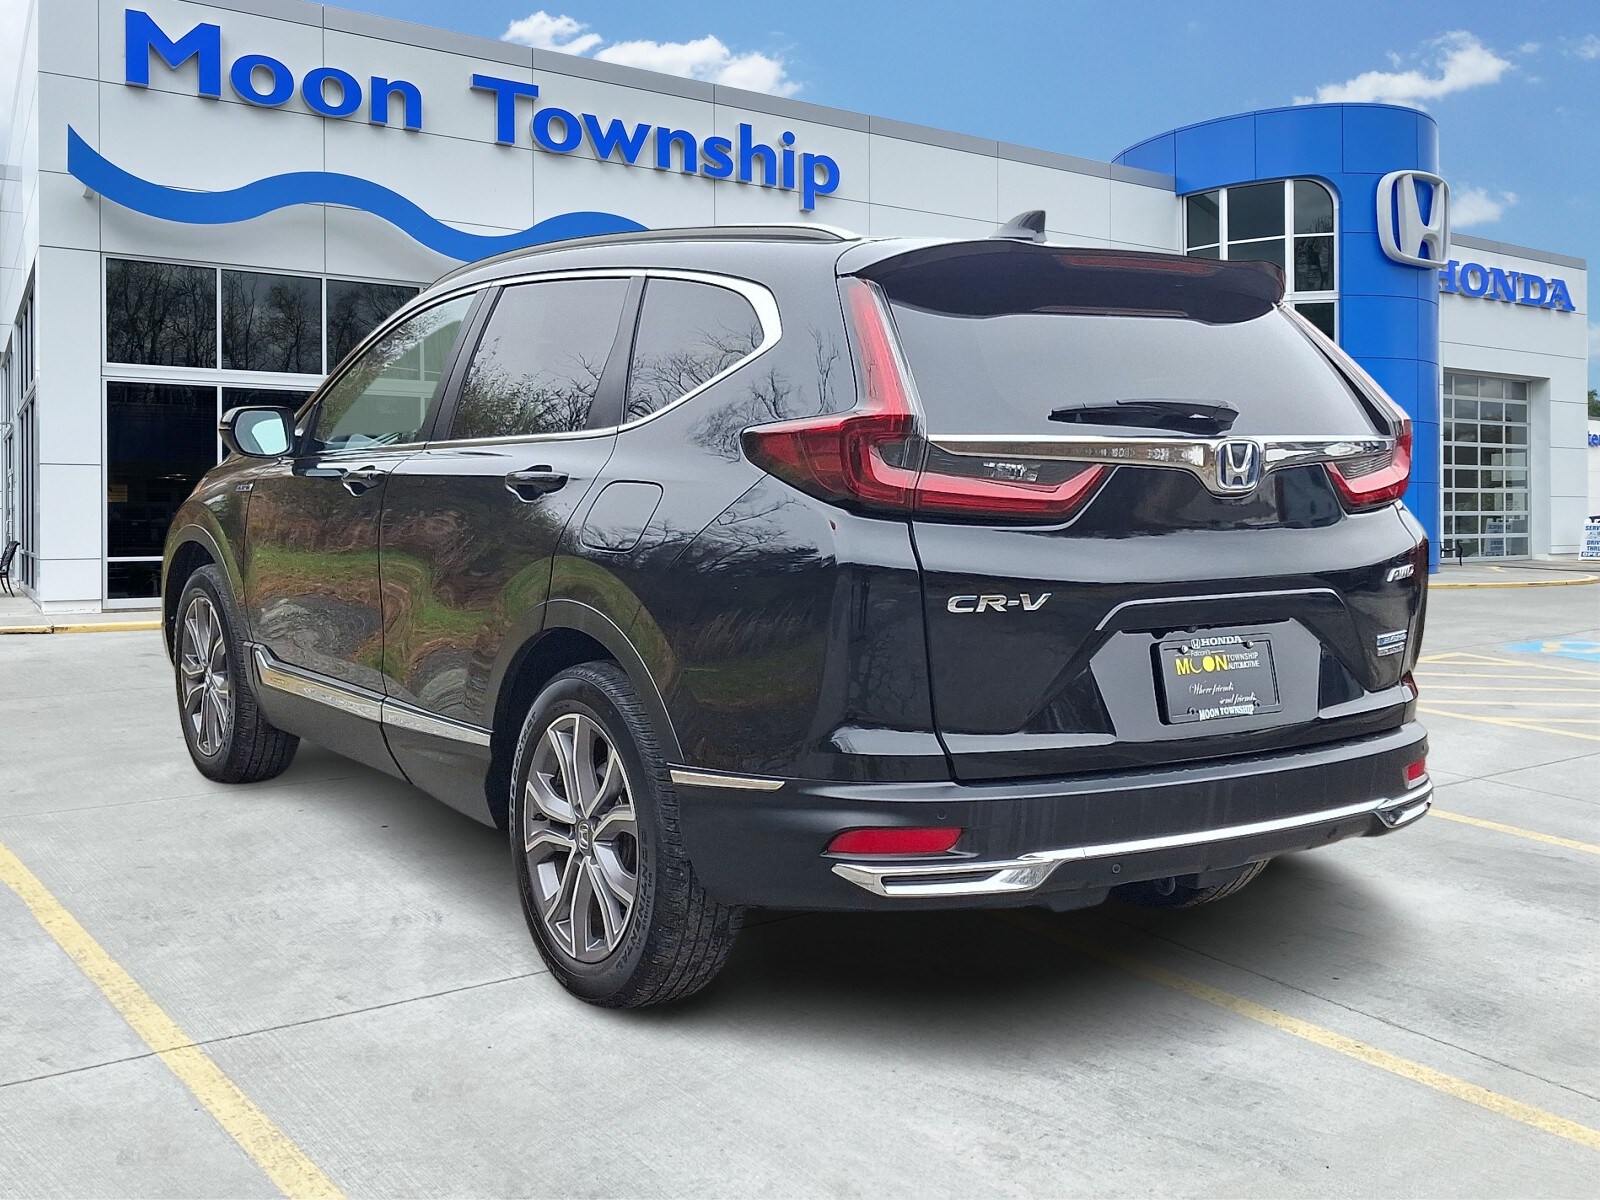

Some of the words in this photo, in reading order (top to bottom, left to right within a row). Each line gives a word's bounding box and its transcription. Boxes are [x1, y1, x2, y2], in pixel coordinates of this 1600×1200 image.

[125, 9, 422, 131] Moon
[469, 73, 841, 212] Township
[947, 593, 1052, 613] CR-V
[1200, 635, 1243, 646] HONDA
[1175, 655, 1228, 675] MOON
[1228, 652, 1259, 661] TOWNSHIP
[1228, 660, 1260, 670] AUTOMOTIVE
[1199, 707, 1219, 721] MOON
[1220, 704, 1255, 716] TOWNSHIP
